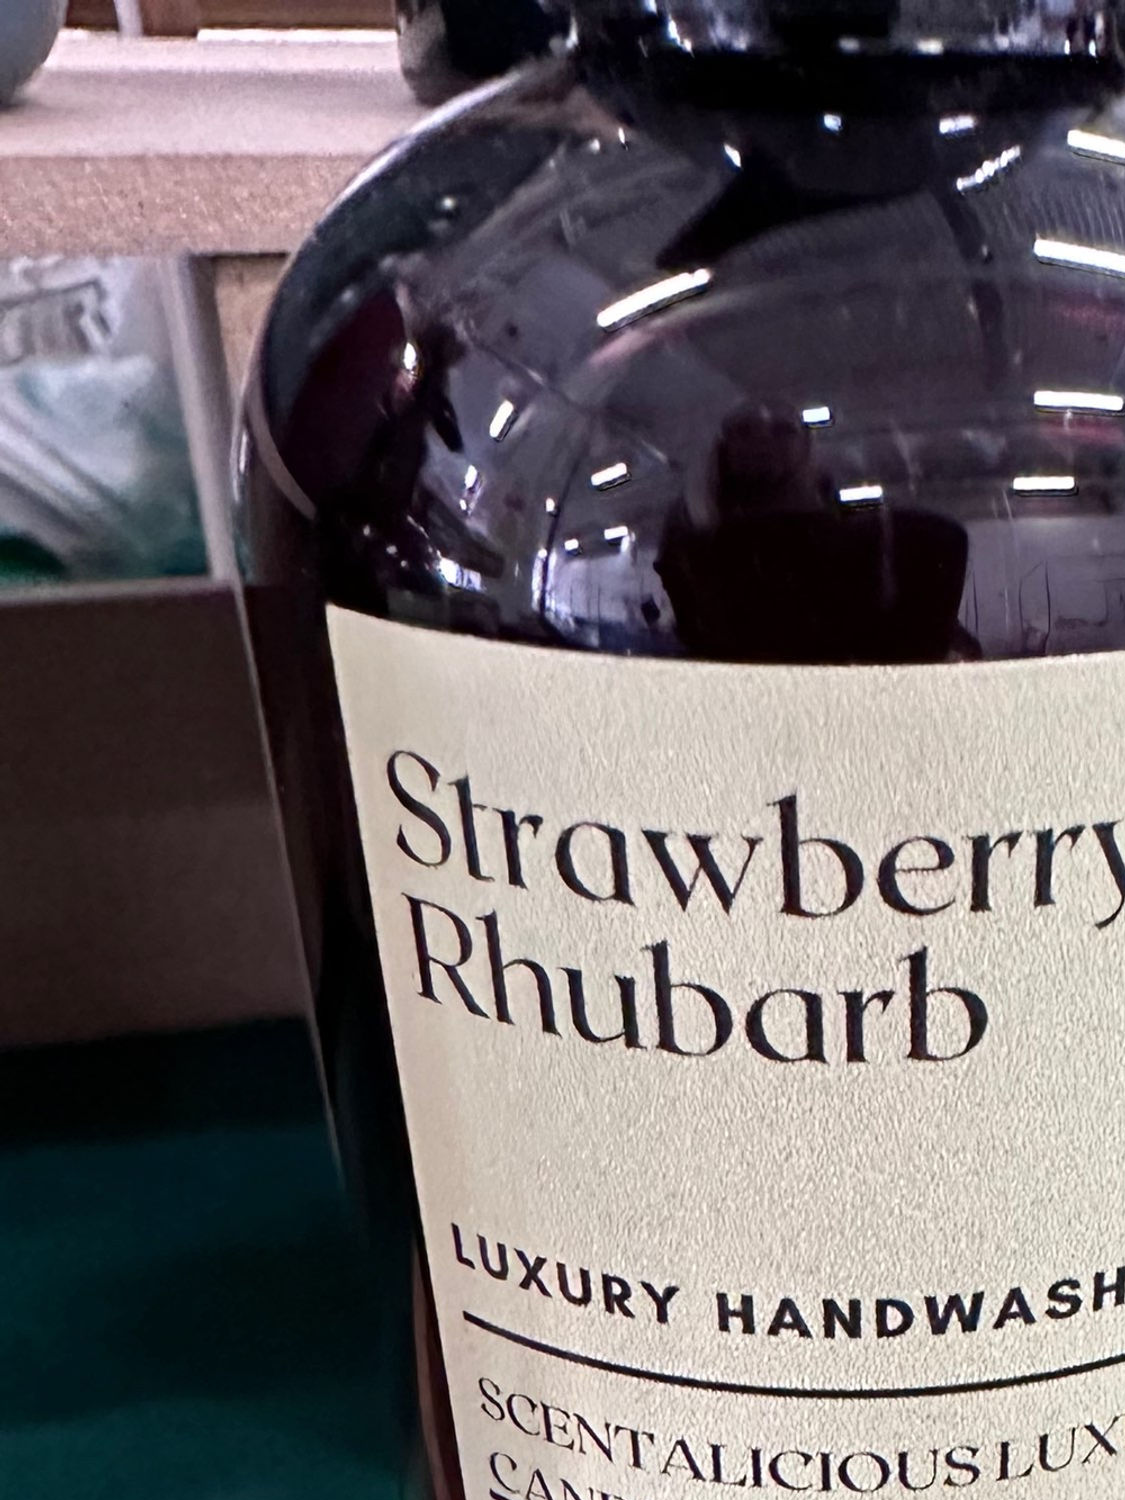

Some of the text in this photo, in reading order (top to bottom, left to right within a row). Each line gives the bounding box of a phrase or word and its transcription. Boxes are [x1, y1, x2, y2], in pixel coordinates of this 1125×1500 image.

[401, 891, 989, 1064] Rhubarb
[451, 1222, 680, 1325] LUXURY
[477, 1376, 981, 1494] SCENTALICIOUS
